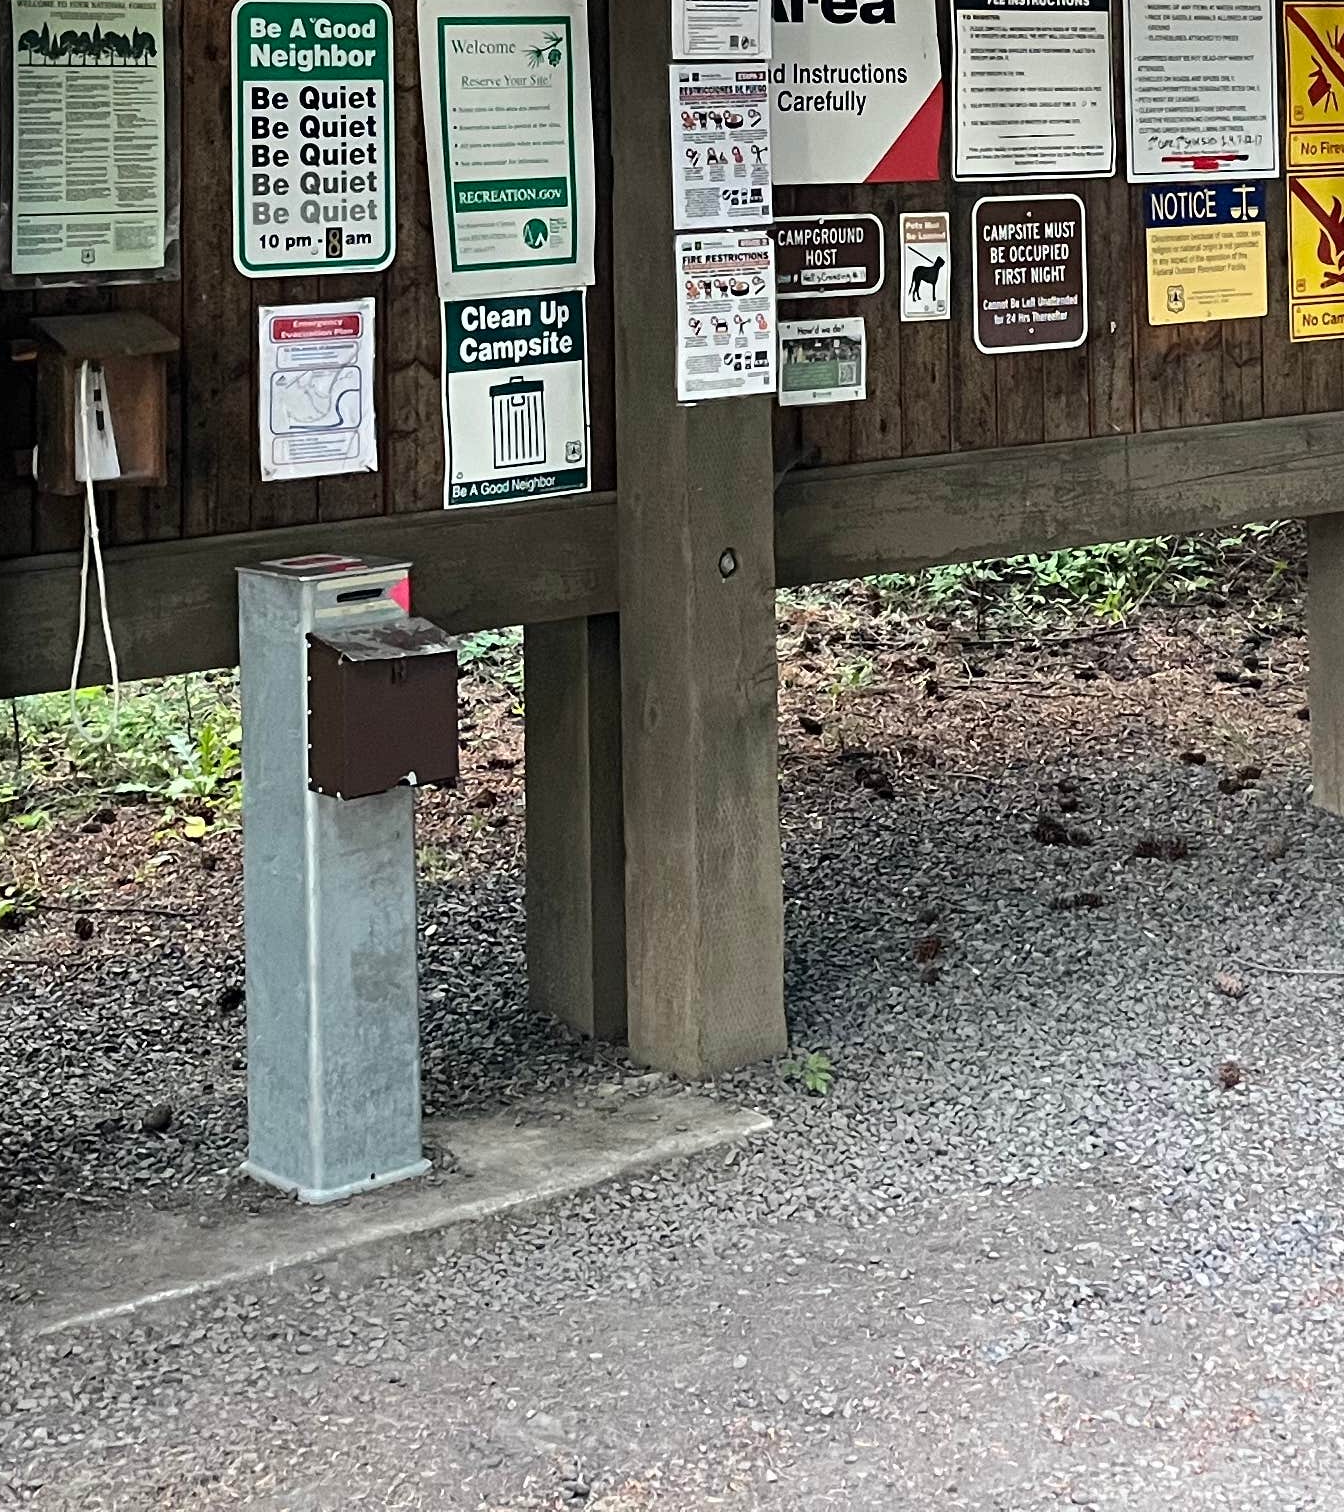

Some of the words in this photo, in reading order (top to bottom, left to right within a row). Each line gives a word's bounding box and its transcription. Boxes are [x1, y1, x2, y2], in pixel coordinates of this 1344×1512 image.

[250, 18, 281, 38] Be
[290, 18, 307, 38] A
[314, 18, 376, 39] Good
[451, 40, 516, 54] Welcome
[250, 43, 376, 72] Neighbor
[461, 75, 501, 87] Reserve
[504, 75, 527, 86] Your
[793, 63, 907, 84] Instructions
[251, 87, 289, 109] Be
[299, 86, 376, 111] Quiet
[777, 90, 867, 115] Carefully
[251, 116, 289, 139] Be
[299, 115, 376, 139] Quiet
[252, 144, 289, 167] Be
[300, 142, 377, 167] Quiet
[1300, 142, 1317, 155] No
[252, 173, 289, 196] Be
[300, 170, 377, 195] Quiet
[459, 189, 561, 204] RECREATION.GOV
[1151, 190, 1217, 221] NOTICE
[252, 202, 289, 225] Be
[300, 199, 377, 224] Quiet
[777, 227, 864, 246] CAMPGROUND
[983, 223, 1040, 241] CAMPSITE
[1044, 221, 1075, 238] MUST
[259, 234, 279, 249] 10
[285, 236, 312, 250] pm
[327, 228, 341, 256] 8
[345, 233, 372, 245] am
[683, 256, 702, 264] FIRE
[706, 252, 769, 263] RESTRICTIONS
[806, 249, 837, 266] HOST
[990, 246, 1005, 263] BE
[1009, 244, 1069, 262] OCCUPIED
[994, 268, 1027, 285] FIRST
[1031, 265, 1066, 283] NIGHT
[983, 299, 1008, 310] Cannot
[1010, 298, 1020, 309] Be
[1022, 297, 1036, 308] Left
[1038, 294, 1078, 307] Unattended
[292, 319, 343, 328] Emergency
[461, 305, 531, 331] Clean
[540, 300, 570, 328] Up
[994, 314, 1004, 325] for
[1005, 313, 1016, 324] 24
[1018, 312, 1030, 323] Hrs
[1032, 310, 1068, 322] Thereafter
[1302, 313, 1318, 327] No
[281, 331, 332, 339] Evacuation
[459, 331, 573, 363] Campsite
[452, 486, 467, 498] Be
[469, 484, 478, 496] A
[480, 481, 509, 495] Good
[511, 476, 556, 492] Neighbor
